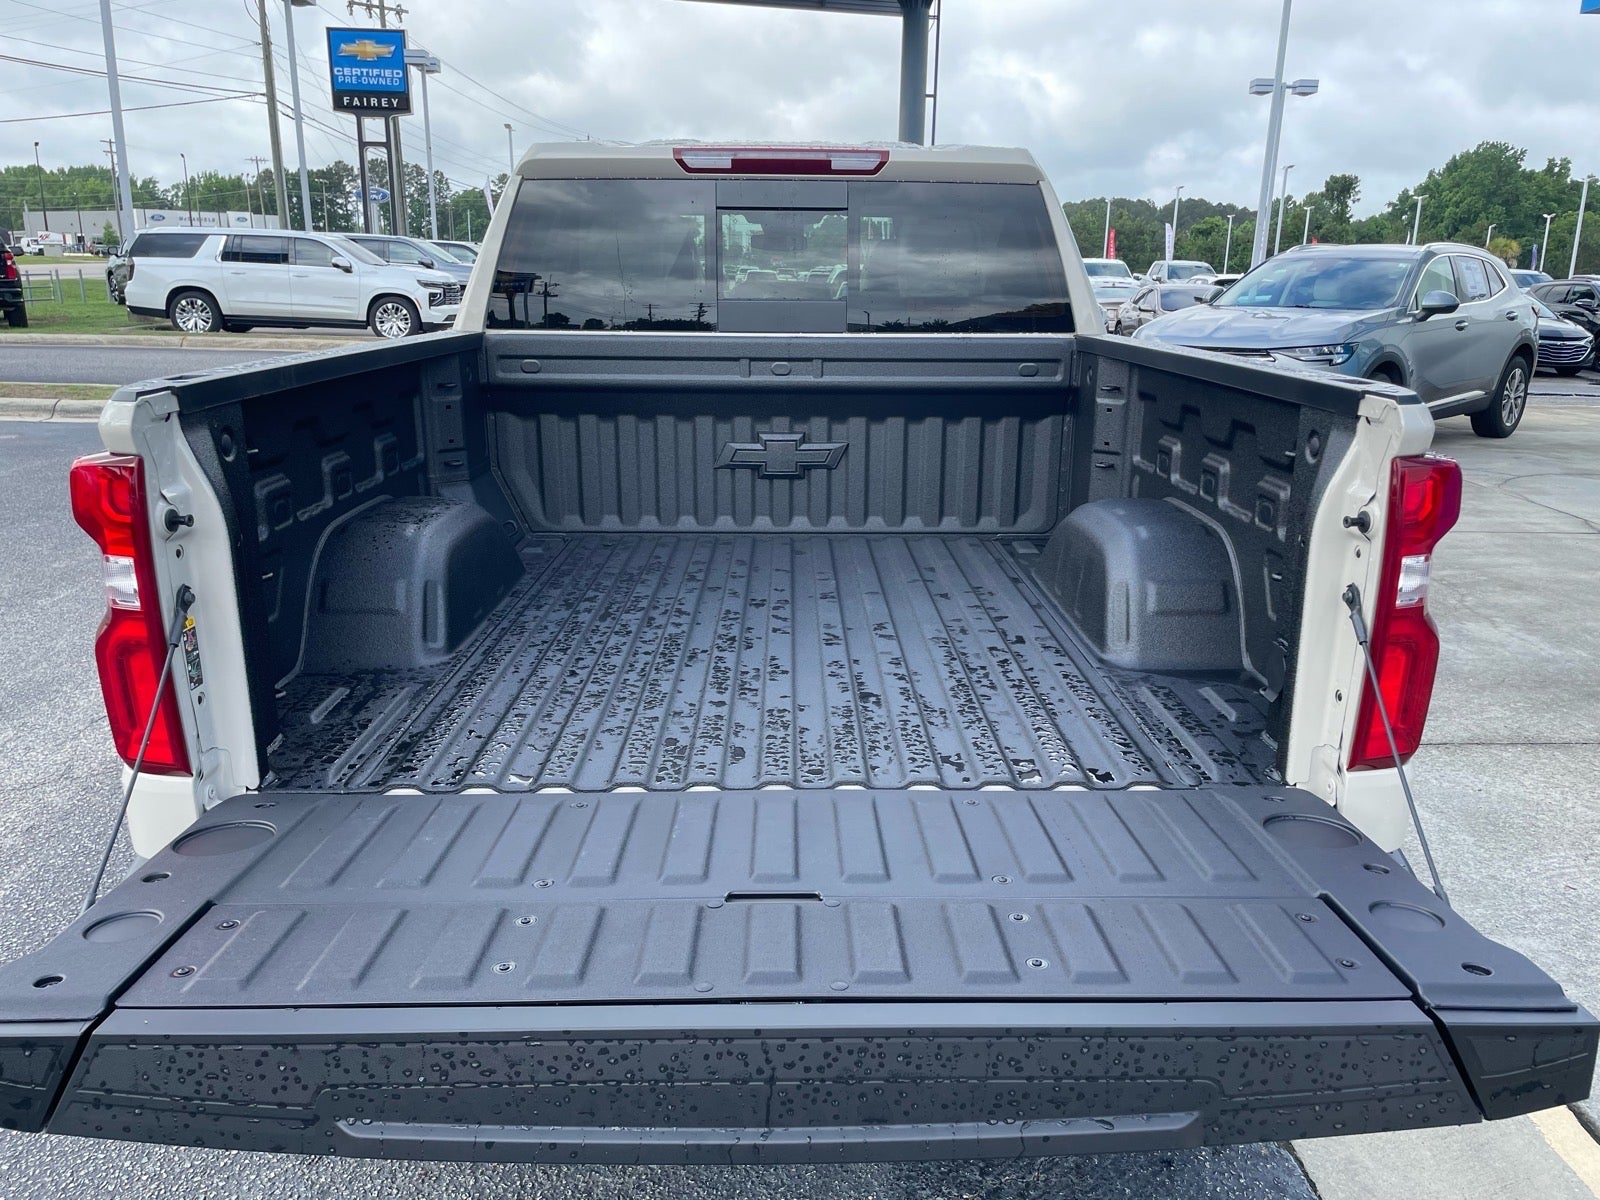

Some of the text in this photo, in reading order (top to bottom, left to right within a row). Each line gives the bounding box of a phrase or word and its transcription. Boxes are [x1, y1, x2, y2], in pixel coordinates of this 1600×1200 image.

[334, 67, 403, 78] CERTIFIED
[338, 76, 399, 86] PRE-OWNED
[343, 97, 398, 107] FAIREY
